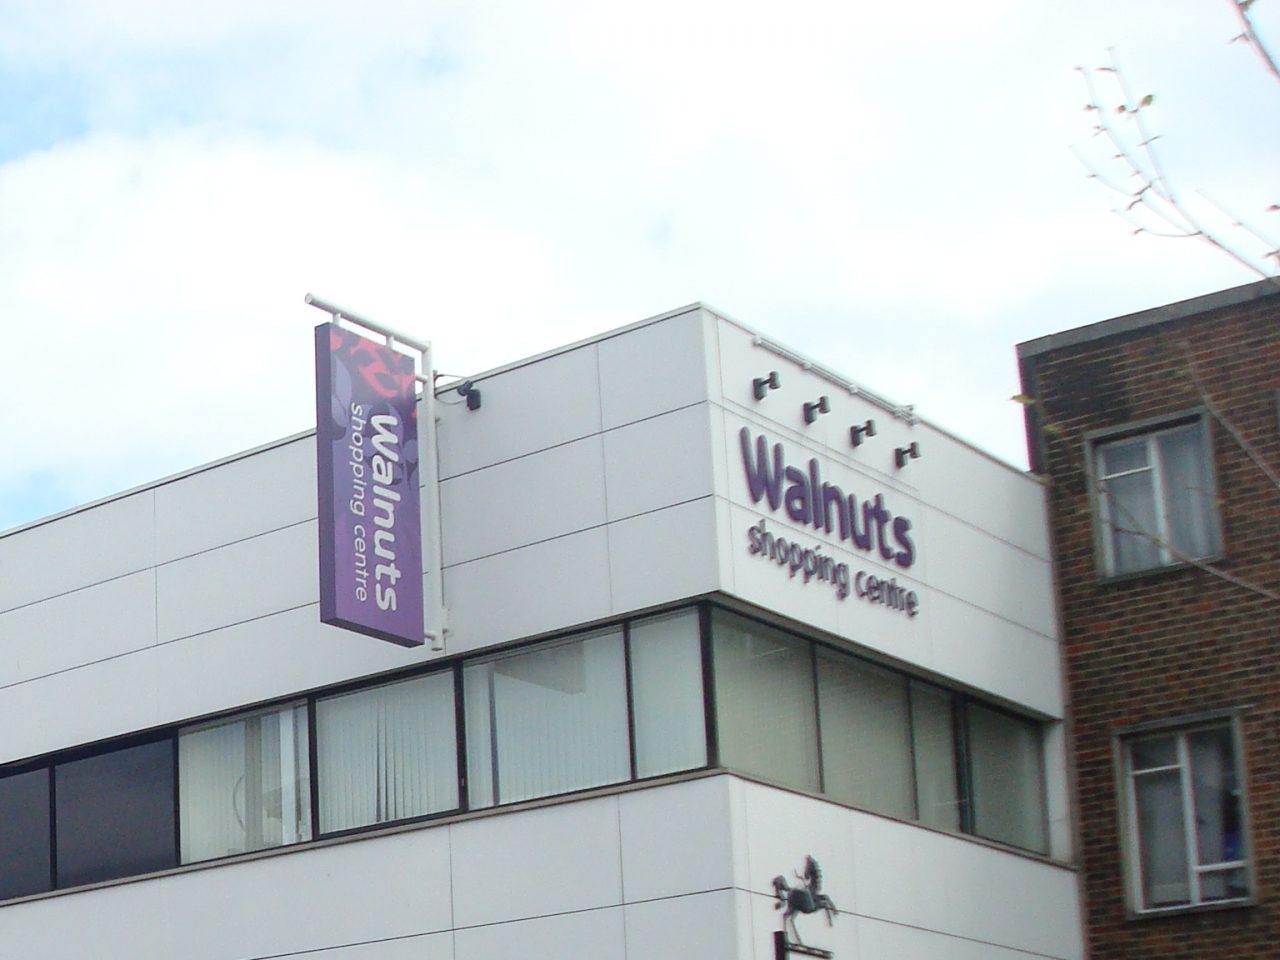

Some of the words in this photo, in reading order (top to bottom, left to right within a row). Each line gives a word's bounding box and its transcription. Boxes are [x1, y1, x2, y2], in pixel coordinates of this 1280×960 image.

[349, 402, 368, 516] shopping
[371, 414, 401, 612] Walnuts
[739, 426, 916, 569] Walnuts
[353, 524, 369, 602] centre
[748, 518, 850, 600] shopping
[855, 570, 919, 618] centre
